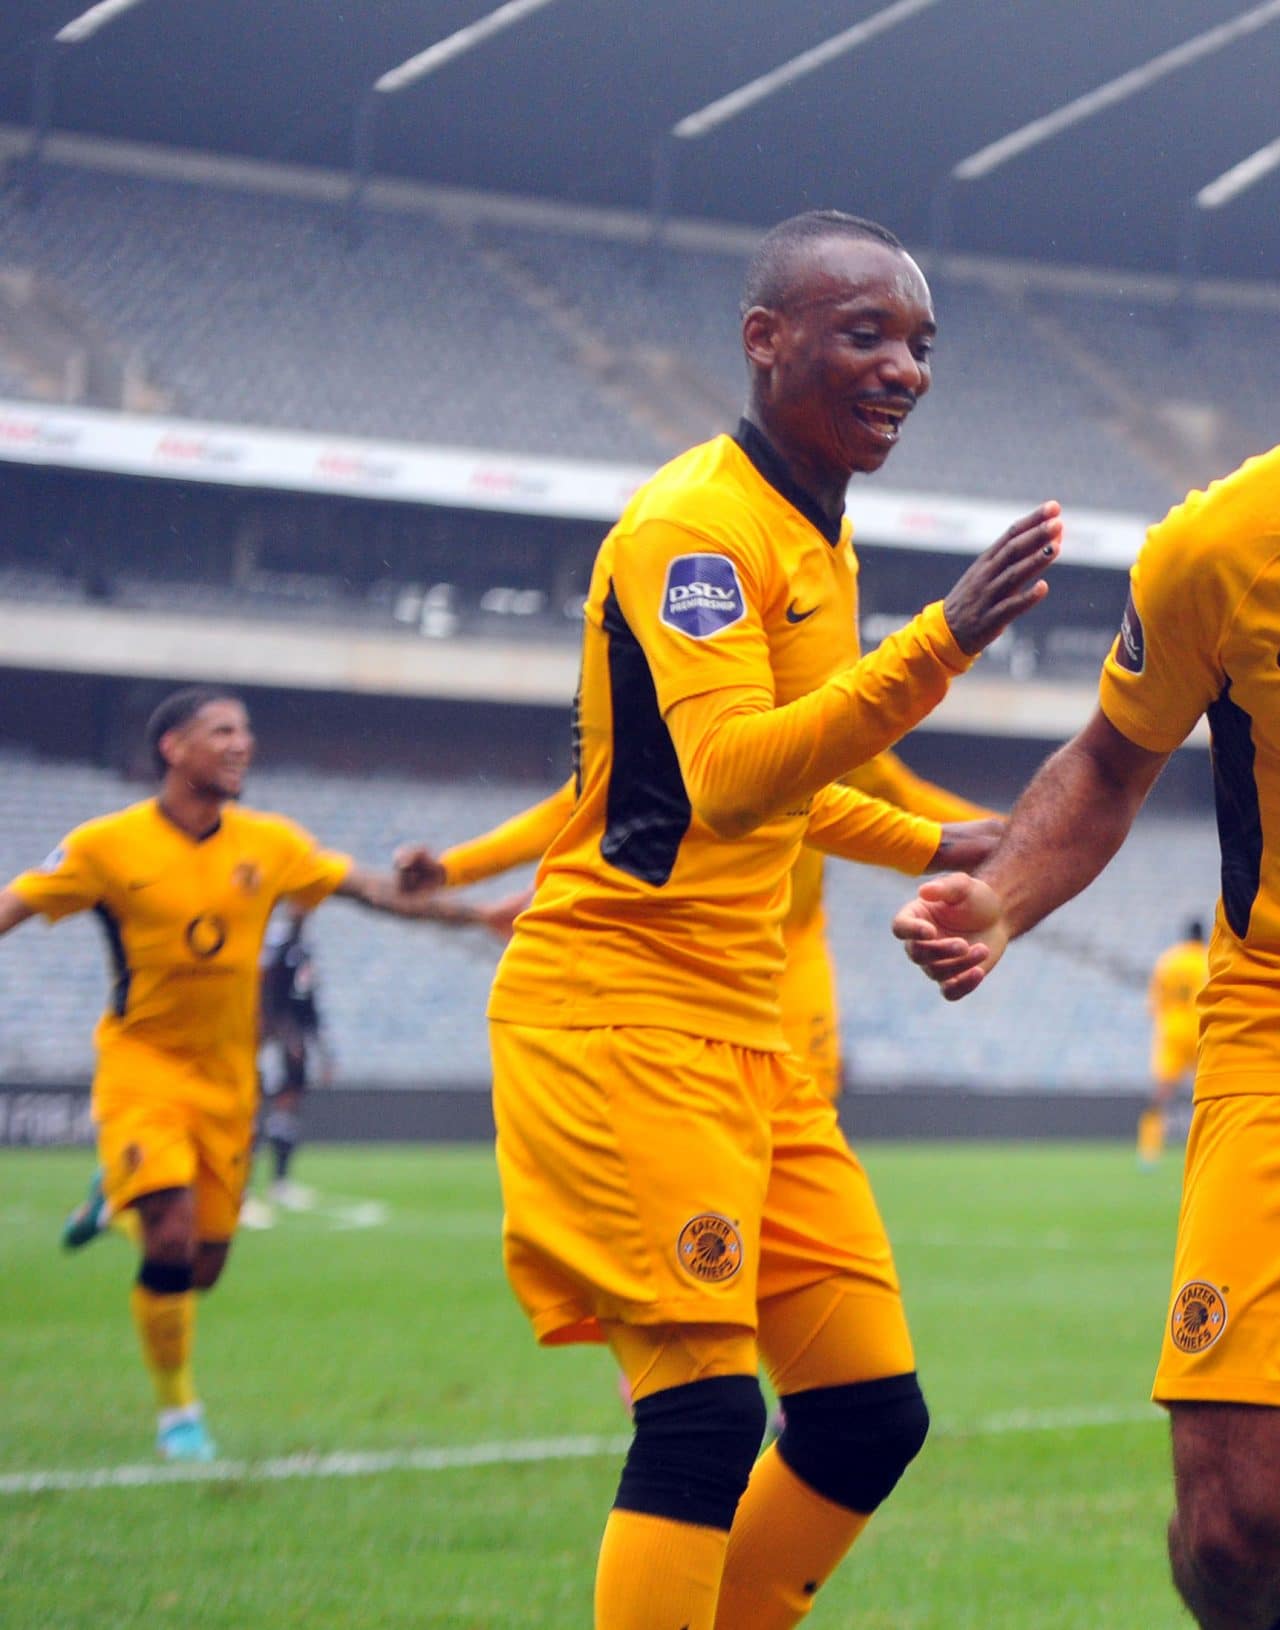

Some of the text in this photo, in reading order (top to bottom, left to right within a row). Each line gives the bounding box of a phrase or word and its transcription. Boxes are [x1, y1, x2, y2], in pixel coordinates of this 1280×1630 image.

[691, 1219, 730, 1239] KAIZER
[689, 1257, 733, 1278] CHIEFS
[1182, 1287, 1216, 1308] KAIZER
[1176, 1327, 1212, 1349] CHIEFS
